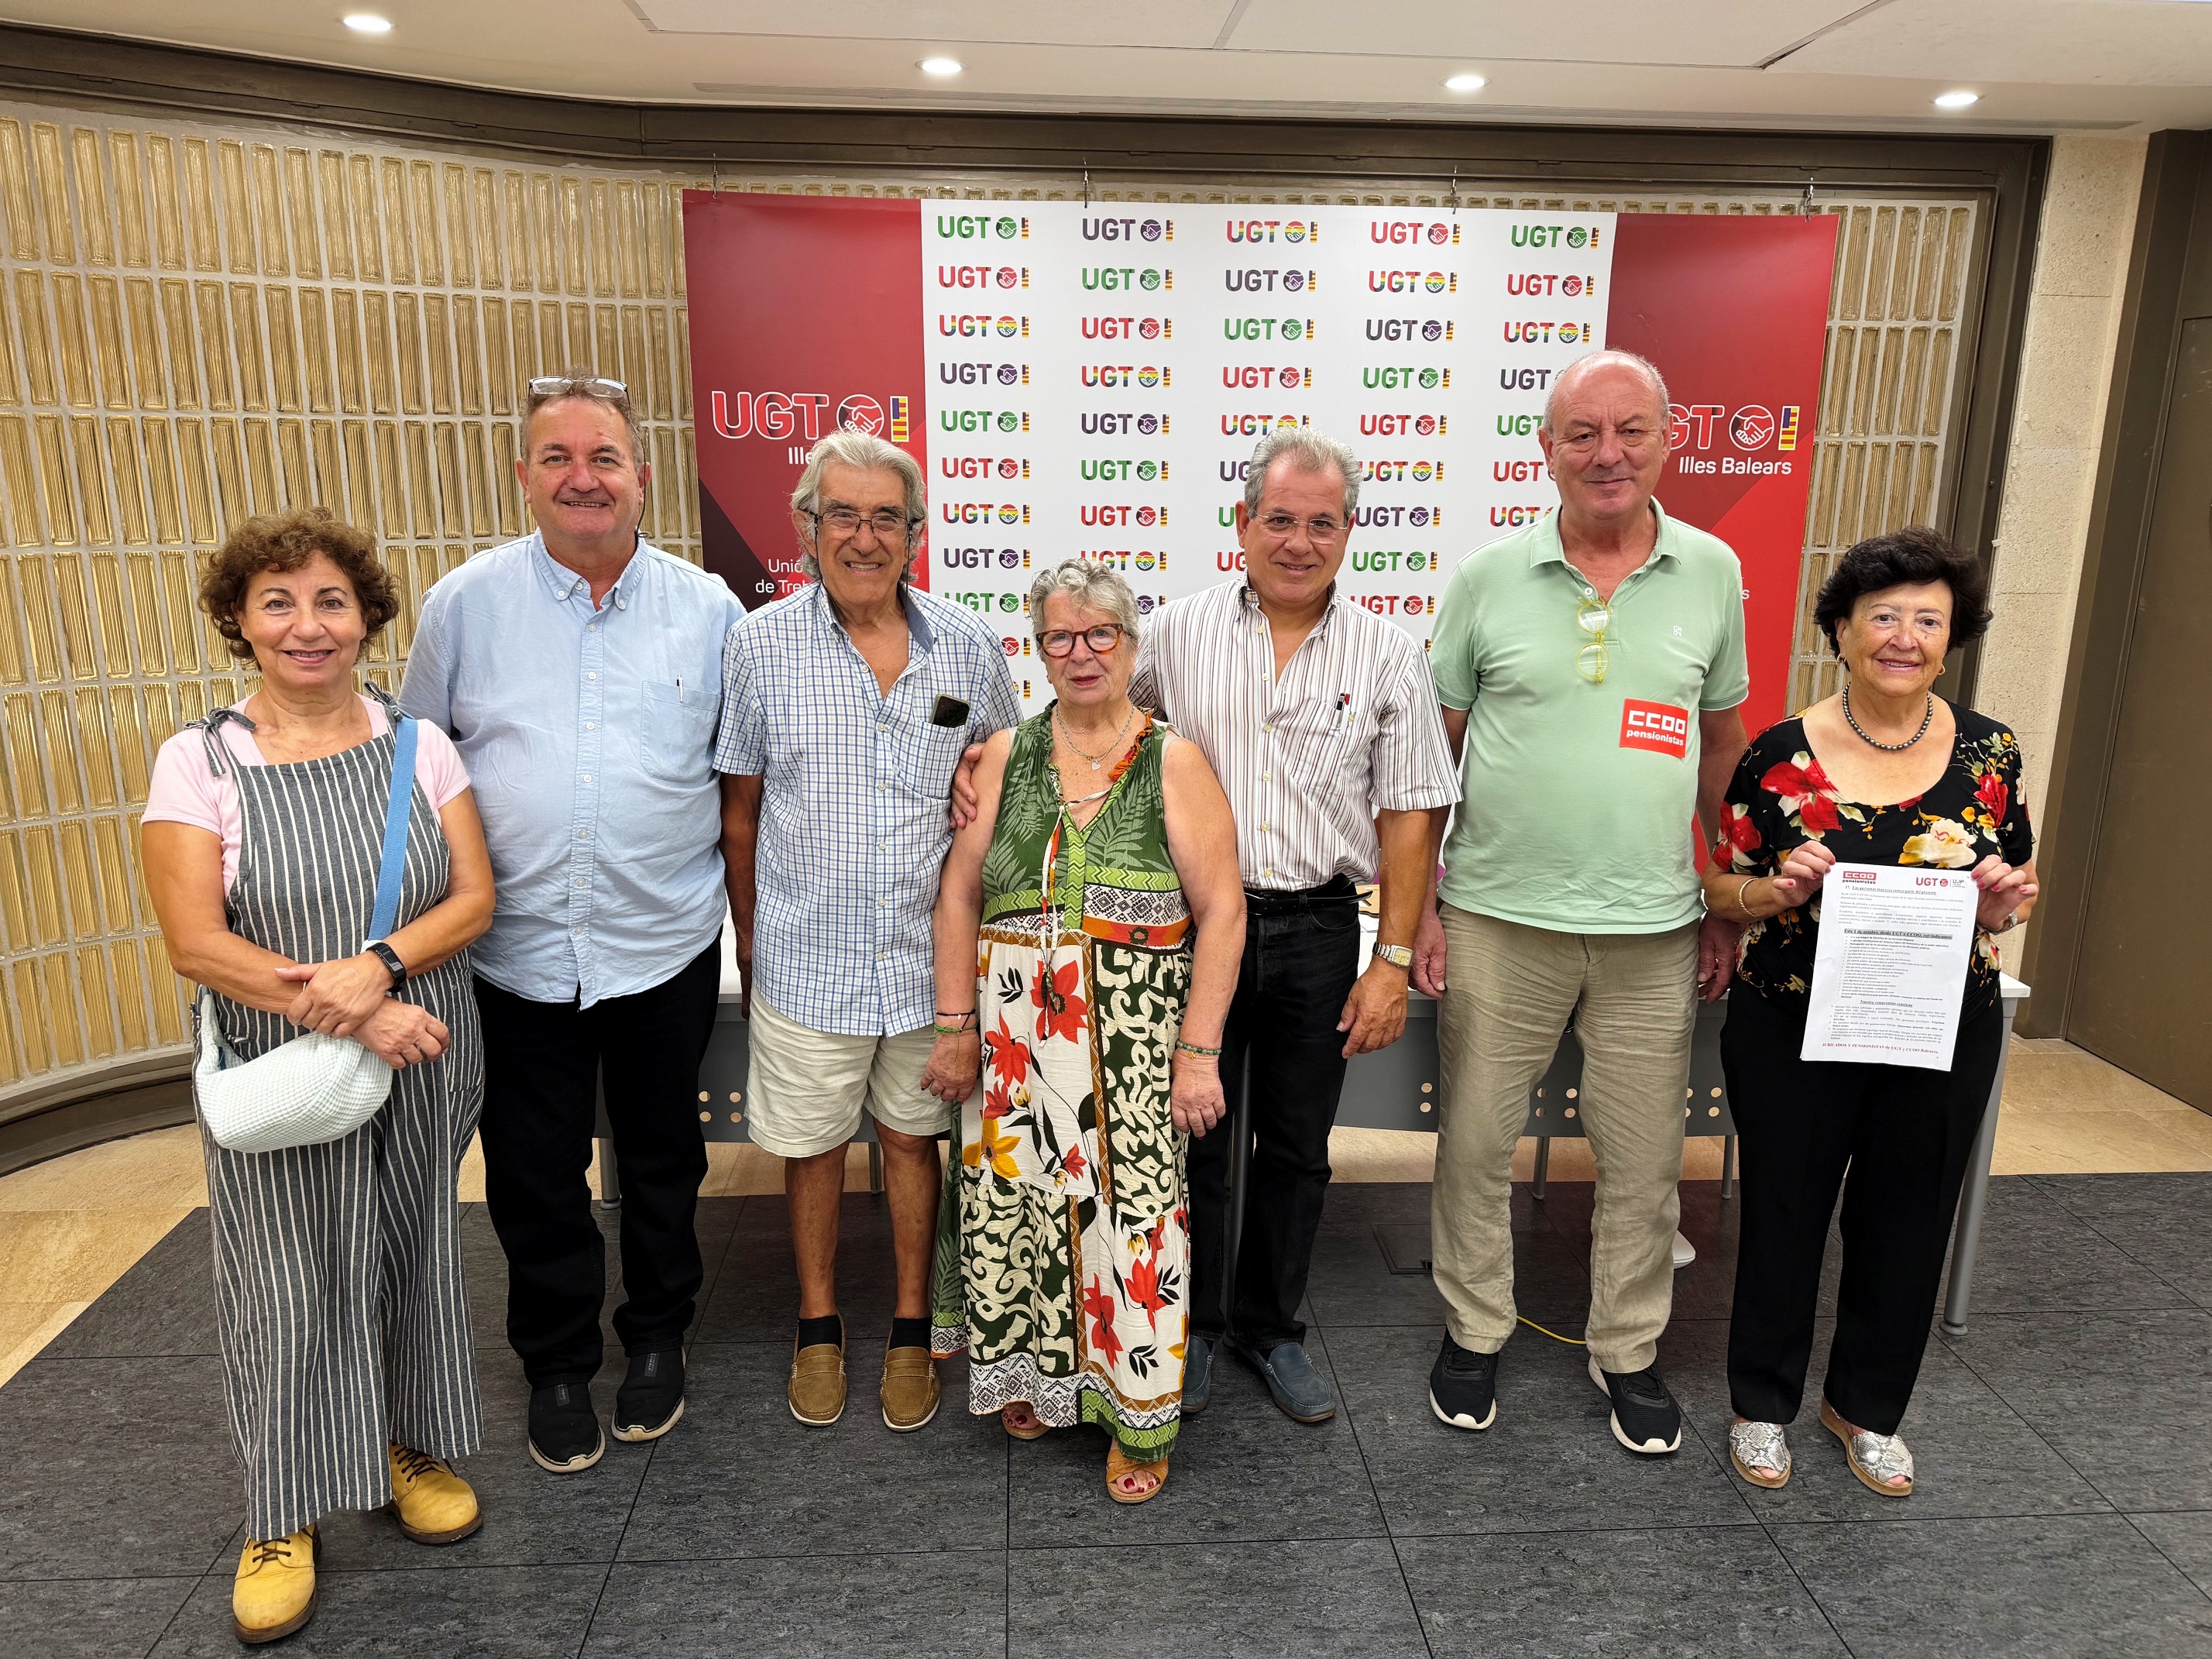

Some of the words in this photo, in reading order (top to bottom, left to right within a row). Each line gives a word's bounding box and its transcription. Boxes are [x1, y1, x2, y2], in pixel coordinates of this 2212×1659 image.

[938, 216, 991, 239] UGT
[1083, 218, 1135, 241] UGT
[1228, 221, 1280, 242] UGT
[1372, 222, 1424, 244] UGT
[1512, 225, 1563, 247] UGT
[939, 266, 991, 288] UGT
[1083, 268, 1135, 290] UGT
[1226, 270, 1278, 291] UGT
[1369, 271, 1420, 293] UGT
[1508, 274, 1558, 296] UGT
[939, 315, 991, 337] UGT
[1082, 318, 1134, 339] UGT
[1224, 318, 1276, 340] UGT
[1366, 319, 1417, 341] UGT
[1504, 322, 1554, 343] UGT
[940, 363, 992, 384] UGT
[1082, 366, 1133, 387] UGT
[1223, 367, 1275, 388] UGT
[1363, 367, 1414, 389] UGT
[1500, 369, 1551, 390] UGT
[712, 390, 830, 440] UGT
[942, 410, 992, 431] UGT
[1082, 414, 1132, 434] UGT
[1221, 414, 1273, 435] UGT
[1361, 414, 1411, 435] UGT
[1669, 404, 1725, 449] GT
[788, 447, 812, 464] Ille
[1679, 456, 1716, 474] Illes
[1722, 457, 1792, 475] Balears
[943, 458, 993, 478] UGT
[1081, 460, 1132, 480] UGT
[1220, 461, 1250, 482] UG
[1493, 462, 1544, 482] UGT
[943, 503, 994, 524] UGT
[1081, 506, 1131, 526] UGT
[1355, 507, 1406, 527] UGT
[1489, 507, 1540, 527] UGT
[768, 558, 803, 572] Unió
[944, 548, 994, 568] UGT
[1352, 551, 1402, 572] UGT
[755, 579, 775, 593] de
[1628, 710, 1685, 734] CCOO
[1626, 729, 1684, 746] pensionistas
[1915, 877, 1939, 887] UGT
